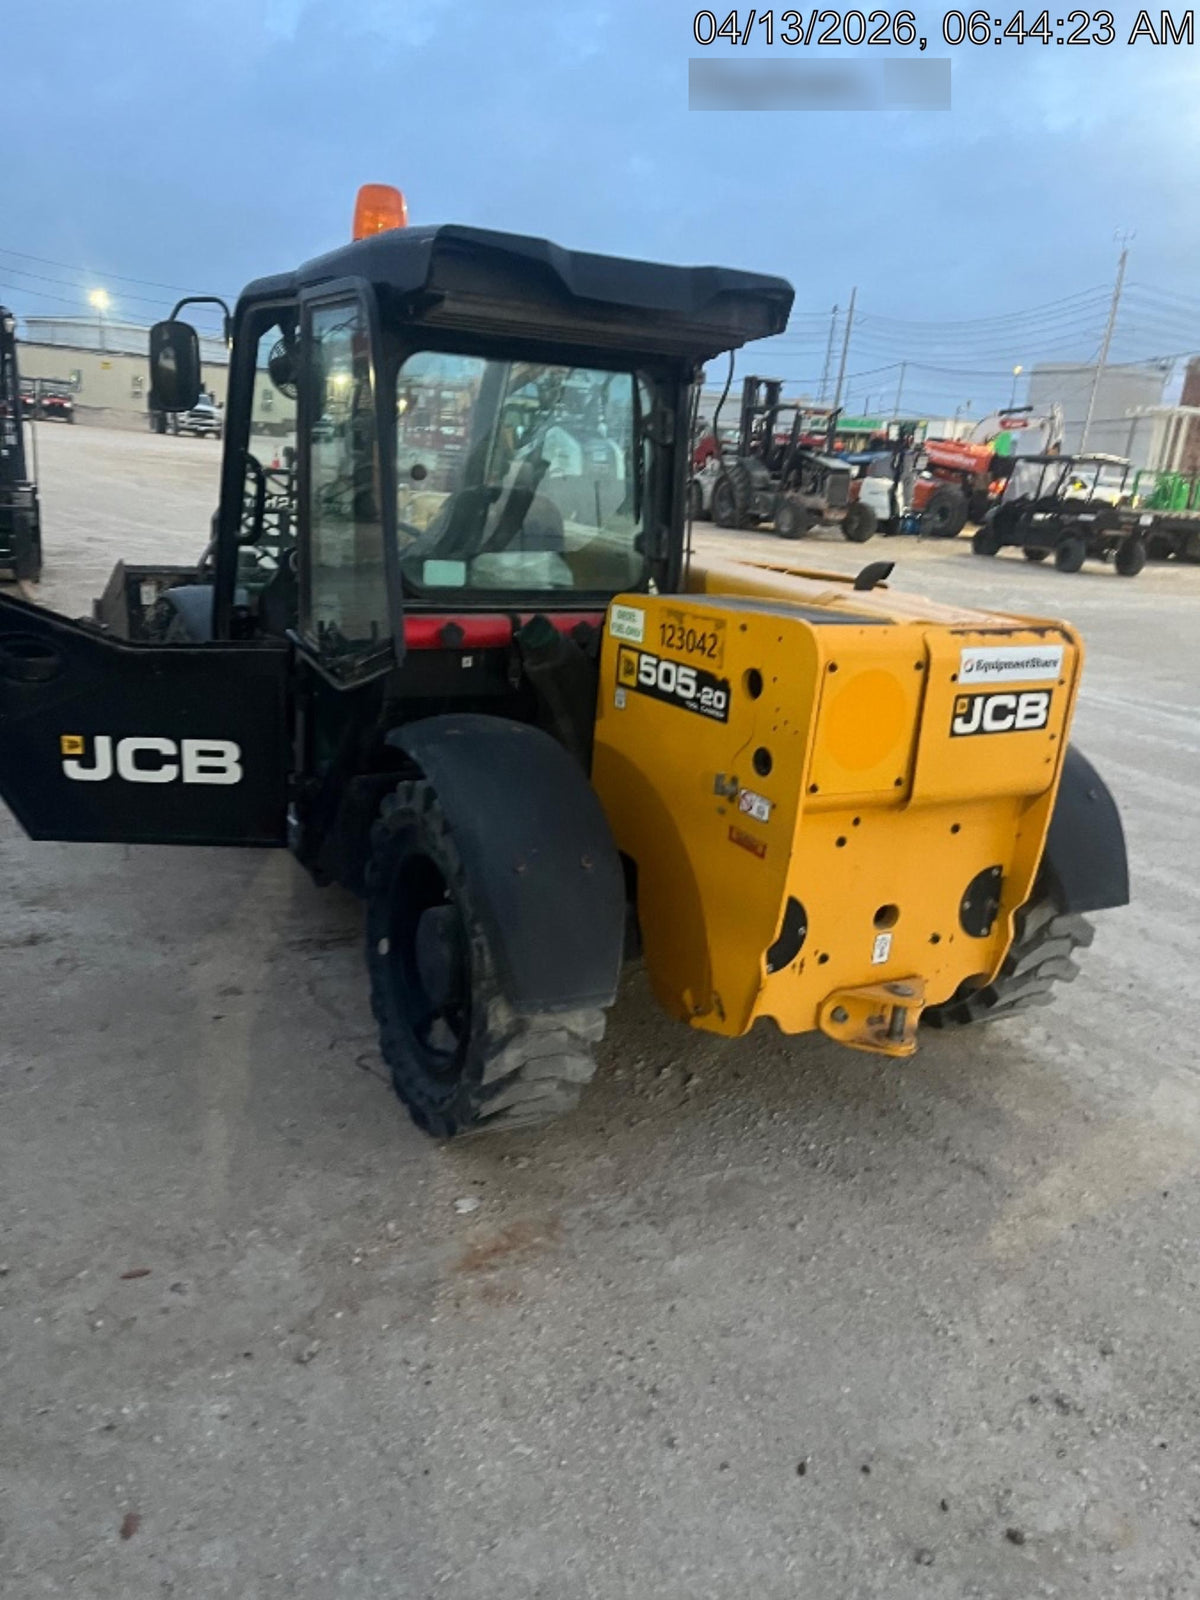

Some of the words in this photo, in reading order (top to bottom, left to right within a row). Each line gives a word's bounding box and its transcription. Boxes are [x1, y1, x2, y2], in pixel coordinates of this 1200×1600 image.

[660, 623, 718, 658] 123042
[976, 657, 1059, 673] EquipmentShare
[952, 692, 1049, 735] JCB
[61, 735, 243, 785] JCB
